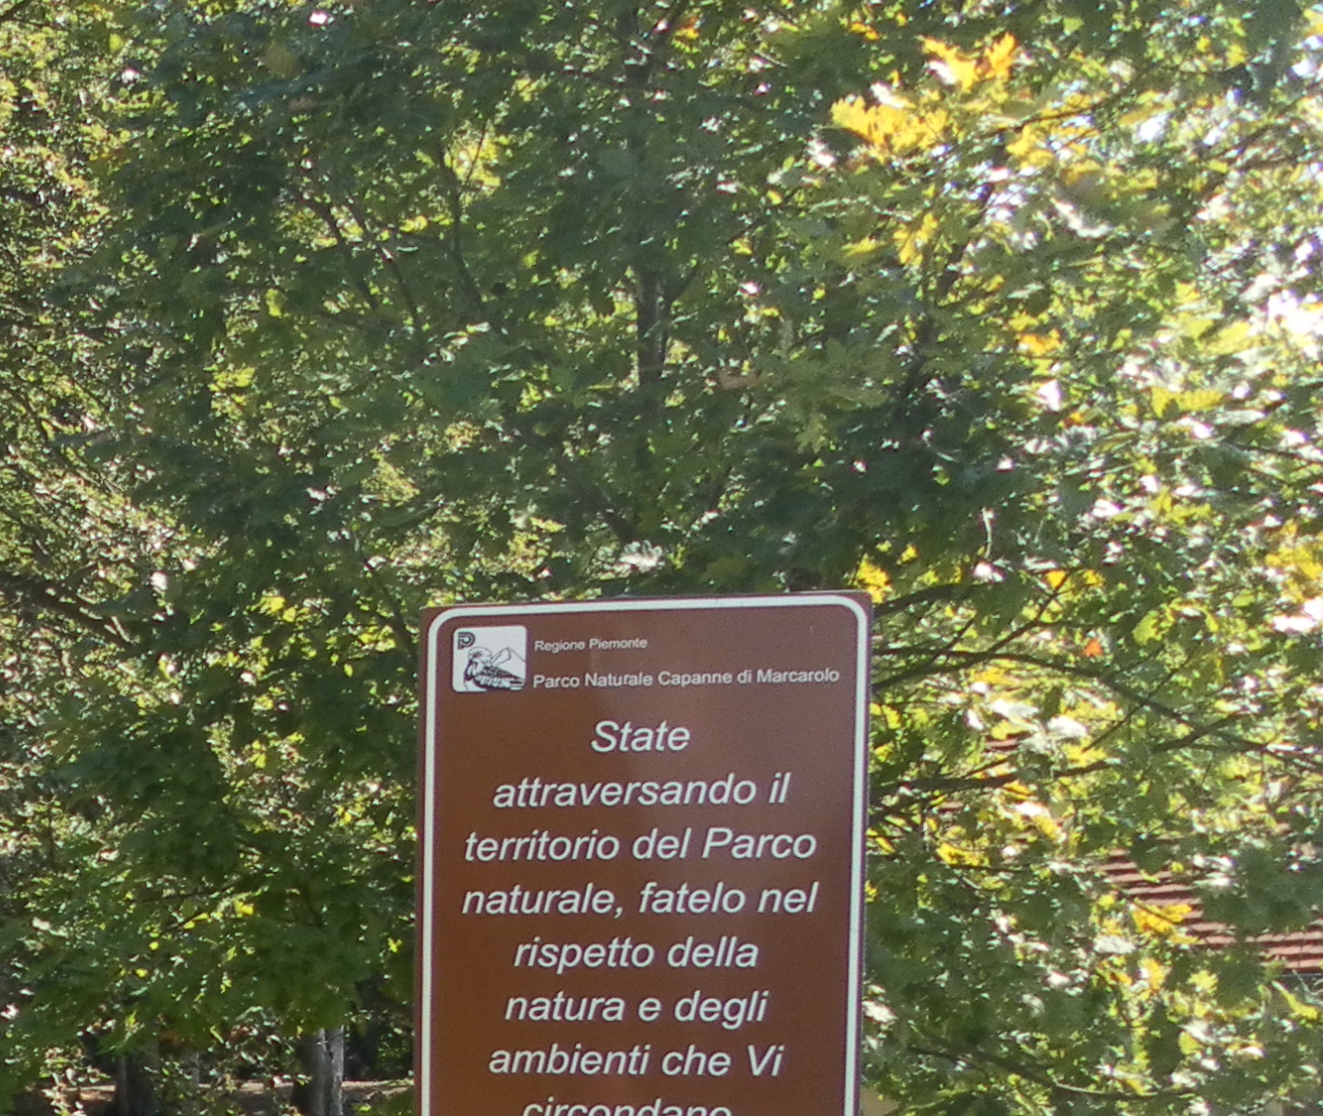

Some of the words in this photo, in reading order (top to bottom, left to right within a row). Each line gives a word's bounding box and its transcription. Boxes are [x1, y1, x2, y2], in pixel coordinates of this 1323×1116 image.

[534, 639, 585, 653] Regione
[589, 636, 648, 650] Piemonte
[533, 674, 580, 688] Parco
[585, 671, 653, 687] Naturale
[658, 671, 733, 688] Capanne
[737, 668, 752, 684] di
[757, 667, 840, 683] Marcarolo
[591, 719, 691, 752] State
[493, 772, 756, 808] attraversando
[769, 772, 791, 804] il
[465, 828, 619, 862] territorio
[633, 827, 692, 860] del
[702, 828, 817, 859] Parco
[462, 884, 624, 919] naturale,
[639, 882, 746, 914] fatelo
[758, 882, 819, 913] nel
[514, 937, 655, 974] rispetto
[667, 936, 759, 968] della
[505, 991, 625, 1022] natura
[638, 997, 661, 1022] e
[675, 990, 769, 1030] degli
[489, 1044, 650, 1075] ambienti
[662, 1044, 731, 1076] che
[748, 1045, 785, 1077] Vi
